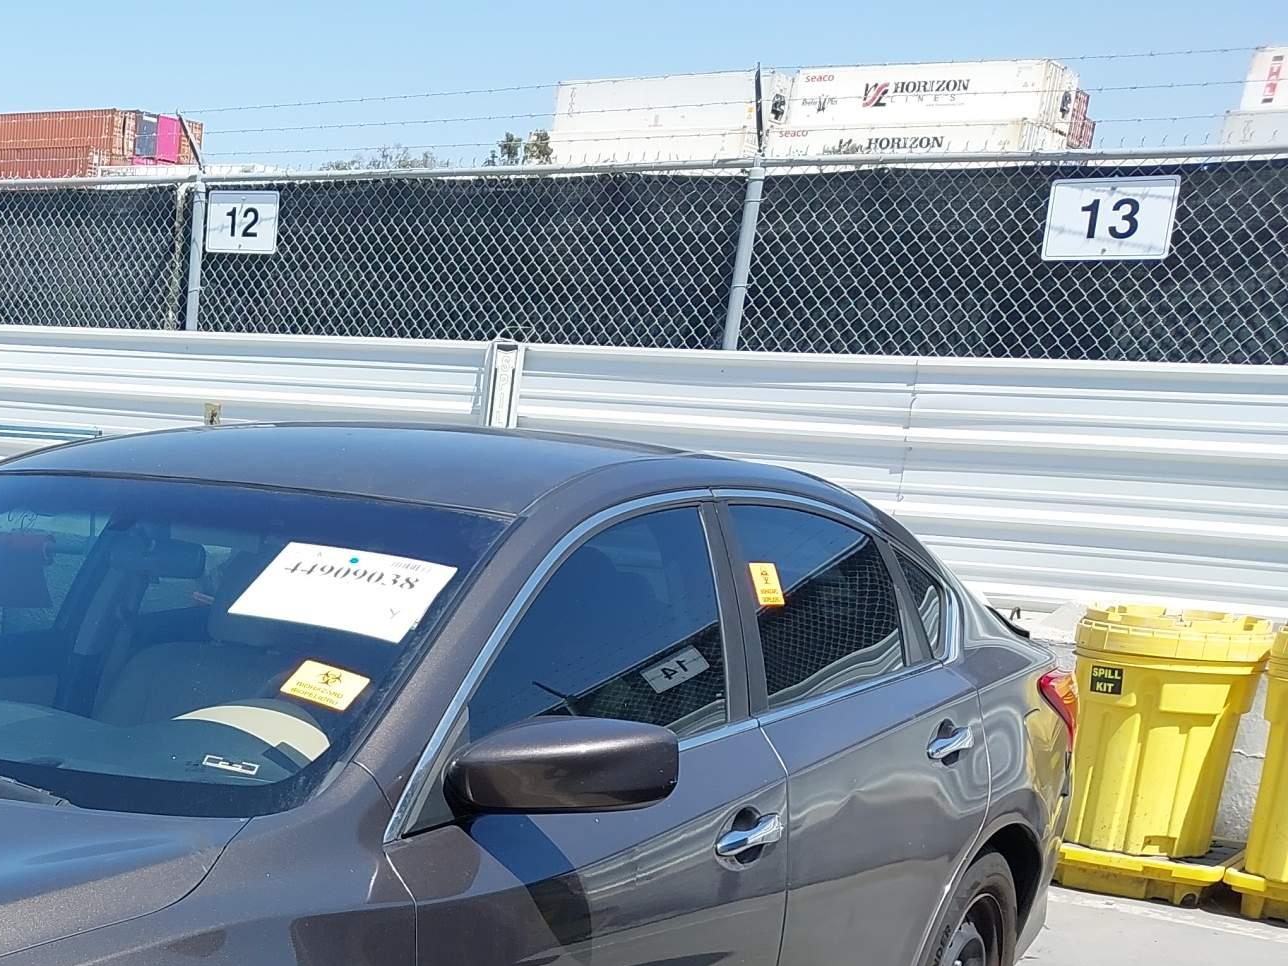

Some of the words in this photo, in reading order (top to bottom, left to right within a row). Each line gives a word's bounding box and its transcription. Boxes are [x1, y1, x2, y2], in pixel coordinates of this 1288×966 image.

[805, 74, 835, 83] seaco
[892, 79, 971, 94] HORIZON
[890, 94, 956, 103] LINES
[778, 129, 809, 138] seaco
[866, 136, 945, 150] HORIZON
[226, 206, 259, 237] 12
[1081, 198, 1140, 239] 13
[284, 561, 420, 590] 44909038
[1092, 667, 1121, 680] SPILL
[1095, 681, 1115, 693] KIT
